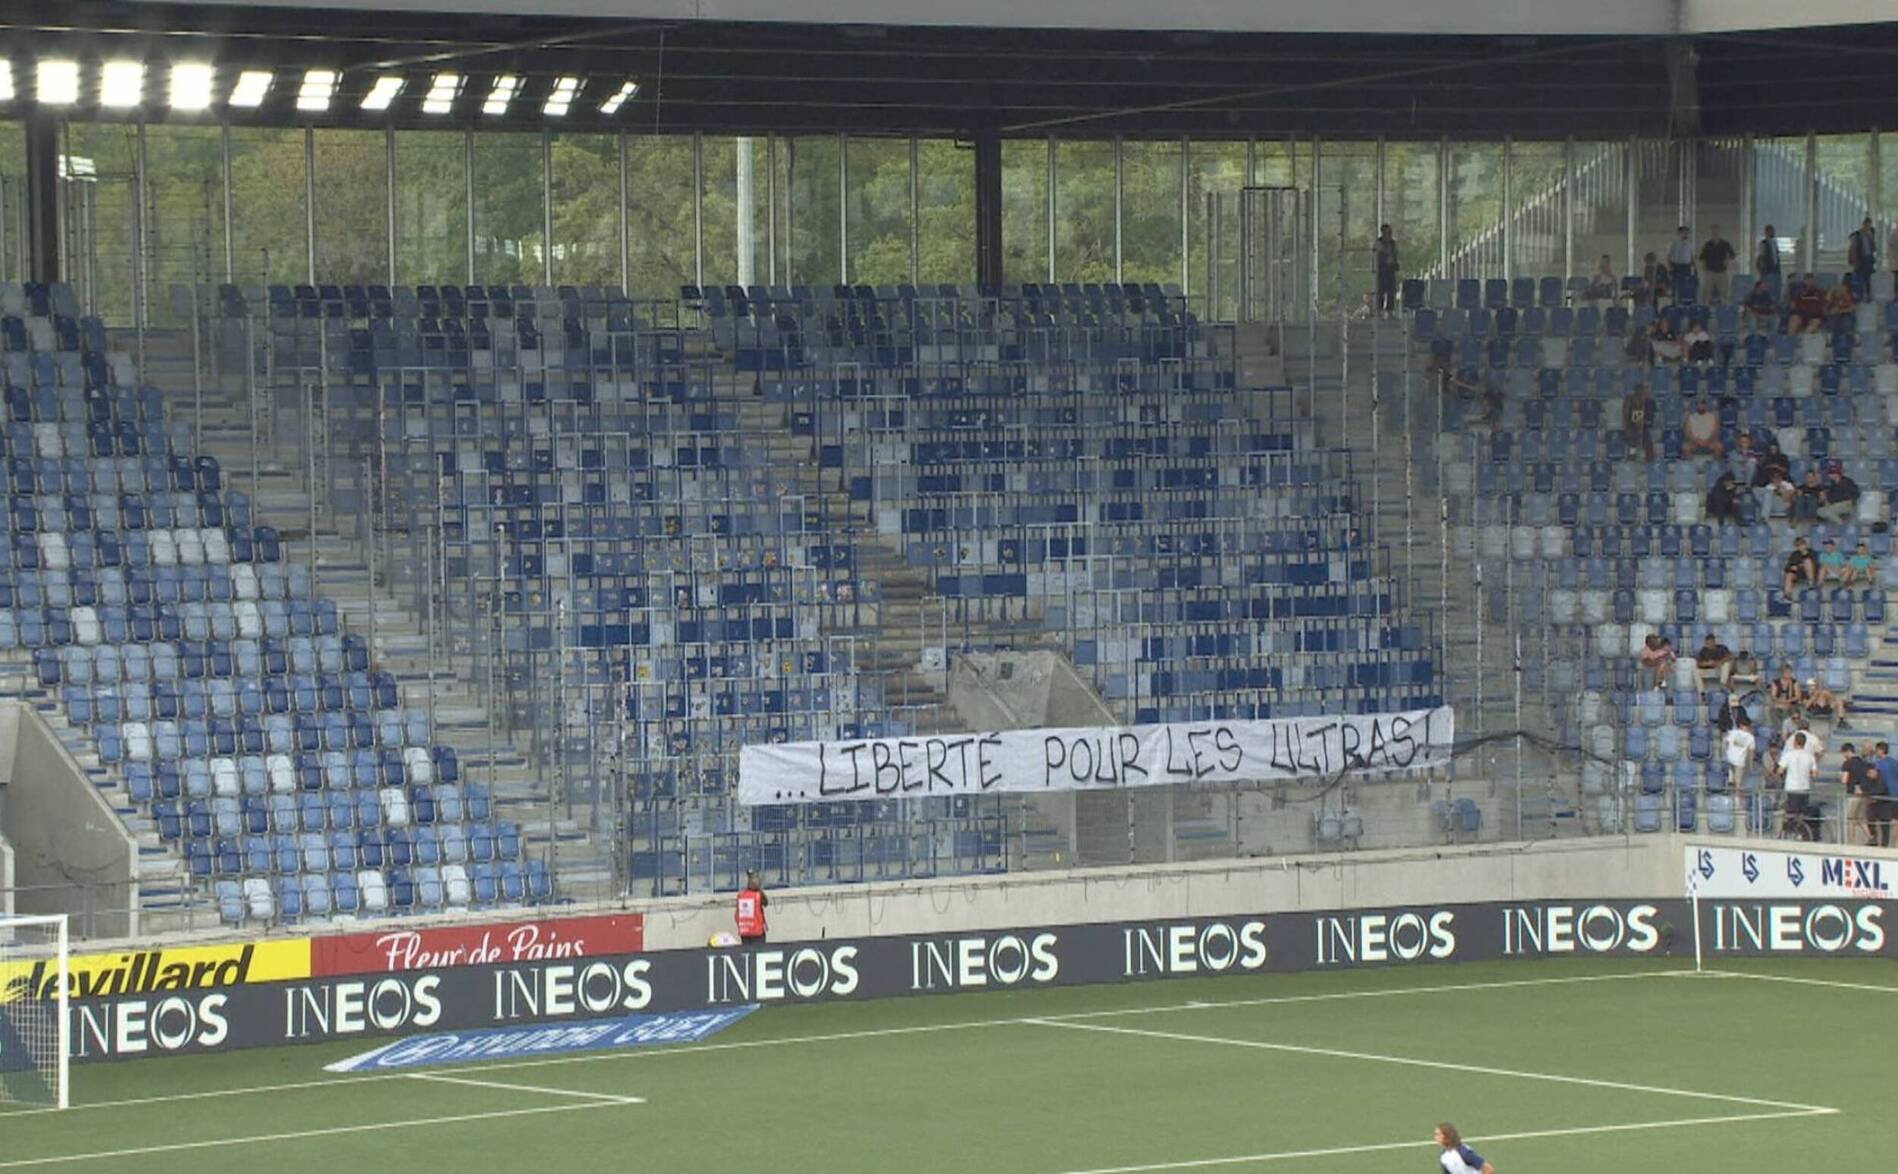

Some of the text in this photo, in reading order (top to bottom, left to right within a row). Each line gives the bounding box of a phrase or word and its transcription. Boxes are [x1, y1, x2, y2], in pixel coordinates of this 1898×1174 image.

[1046, 733, 1150, 785] POUR
[1165, 725, 1243, 779] LES
[376, 924, 584, 971] Fleur de Pains
[1123, 922, 1267, 976] INEOS
[1315, 911, 1456, 964] INEOS
[1502, 905, 1659, 954] INEOS
[1714, 905, 1886, 951] INEOS
[493, 958, 653, 1020] INEOS
[706, 946, 859, 1002] INEOS
[910, 933, 1059, 990] INEOS
[67, 993, 229, 1058] INEOS
[285, 976, 442, 1038] INEOS
